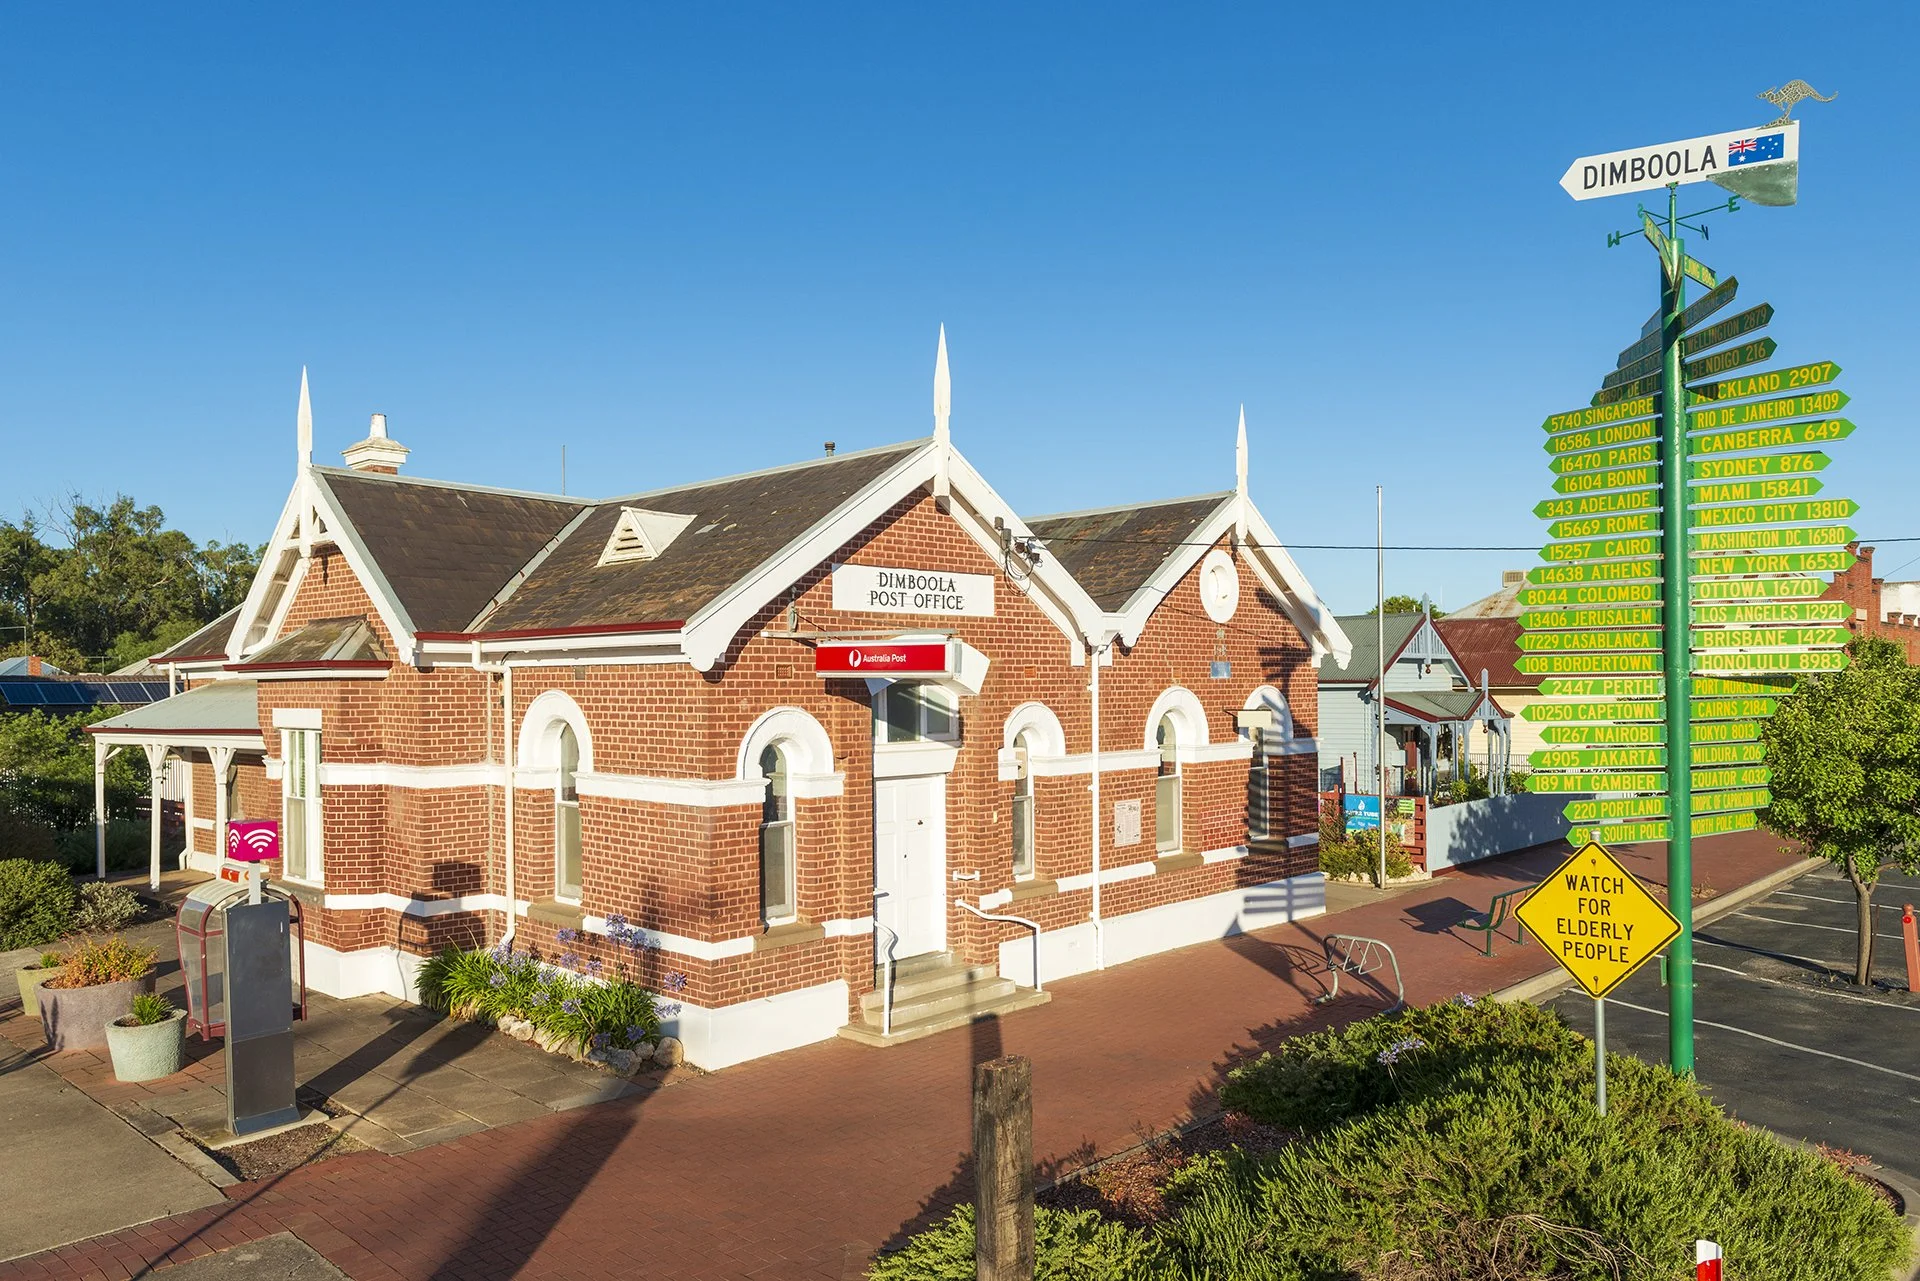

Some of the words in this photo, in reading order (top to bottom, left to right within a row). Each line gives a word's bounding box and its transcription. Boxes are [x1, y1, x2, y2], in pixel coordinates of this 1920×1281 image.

[1584, 145, 1717, 189] DIMBOOLA
[1687, 318, 1739, 351] WELLINGTON
[1743, 306, 1767, 329] 2879
[1691, 349, 1740, 379] BENDIGO
[1745, 342, 1766, 363] 216
[1627, 375, 1657, 399] DELHI
[1696, 373, 1780, 404] AUCKLAND
[1789, 363, 1832, 387] 2907
[1551, 412, 1581, 432] 5740
[1585, 397, 1654, 425] SINGAPORE
[1697, 411, 1716, 428] RIO
[1721, 408, 1736, 425] DE
[1742, 399, 1795, 422] JANEIRO
[1800, 392, 1839, 414] 13409
[1555, 432, 1591, 452] 16586
[1597, 421, 1651, 445] LONDON
[1701, 427, 1794, 453] CANBERRA
[1804, 421, 1841, 441] 649
[1560, 453, 1601, 472] 16470
[1608, 445, 1651, 466] PARIS
[1701, 457, 1771, 478] SYDNEY
[1780, 454, 1814, 472] 876
[1564, 474, 1602, 492] 16104
[1607, 468, 1647, 487] BONN
[1700, 483, 1750, 503] MIAMI
[1761, 479, 1809, 498] 15841
[1546, 500, 1573, 517] 343
[1579, 491, 1650, 514] ADELAIDE
[1700, 506, 1757, 526] MEXICO
[1763, 504, 1799, 521] CITY
[1806, 500, 1849, 519] 13810
[1558, 519, 1600, 537] 15669
[1606, 514, 1649, 533] ROME
[1549, 543, 1592, 560] 15257
[1605, 538, 1651, 556] CAIRO
[1700, 530, 1779, 550] WASHINGTON
[1785, 529, 1801, 546] DC
[1808, 527, 1845, 545] 16580
[1540, 566, 1584, 584] 14638
[1591, 561, 1651, 580] ATHENS
[1700, 557, 1735, 575] NEW
[1744, 555, 1790, 573] YORK
[1799, 552, 1846, 570] 16531
[878, 571, 956, 593] DIMBOOLA
[1700, 580, 1767, 598] OTTOWA
[1773, 579, 1818, 596] 16701
[870, 590, 907, 607] POST
[914, 593, 964, 611] OFFICE
[1528, 588, 1568, 605] 8044
[1577, 585, 1651, 603] COLOMBO
[1529, 612, 1567, 627] 13406
[1572, 608, 1651, 626] JERUSALEM
[1701, 606, 1727, 622] LOS
[1735, 605, 1798, 621] ANGELES
[1805, 603, 1843, 620] 12921
[1524, 634, 1560, 650] 17229
[1563, 632, 1650, 649] CASABLANCA
[1703, 630, 1788, 647] BRISBANE
[1796, 628, 1837, 645] 1422
[863, 653, 891, 663] Australia
[892, 653, 907, 663] Post
[1525, 657, 1549, 672] 108
[1553, 655, 1652, 672] BORDERTOWN
[1702, 653, 1790, 670] HONOLULU
[1799, 653, 1842, 670] 8983
[1552, 680, 1594, 696] 2447
[1603, 679, 1654, 695] PERTH
[1695, 679, 1719, 695] PORT
[1723, 677, 1765, 694] MORESBY
[1769, 677, 1793, 694] 3038
[1531, 704, 1573, 721] 10250
[1577, 703, 1655, 720] CAPETOWN
[1698, 701, 1738, 718] CAIRNS
[1742, 700, 1768, 716] 2184
[1551, 727, 1589, 743] 11267
[1594, 726, 1654, 743] NAIROBI
[1694, 725, 1727, 741] TOKYO
[1731, 723, 1755, 739] 8013
[1541, 751, 1580, 767] 4905
[1590, 749, 1657, 766] JAKARTA
[1693, 746, 1738, 763] MILDURA
[1742, 745, 1761, 761] 206
[1535, 775, 1559, 791] 189
[1563, 775, 1584, 791] MT
[1591, 774, 1656, 791] GAMBIER
[1692, 770, 1737, 788] EQUATOR
[1741, 768, 1767, 784] 4032
[1574, 802, 1597, 820] 220
[1600, 799, 1662, 818] PORTLAND
[1692, 795, 1712, 811] TROPIC
[1713, 794, 1721, 810] OF
[1722, 791, 1754, 809] CAPRICORN
[1576, 827, 1601, 845] 59
[1603, 824, 1636, 843] SOUTH
[1639, 822, 1665, 840] POLE
[1692, 818, 1713, 836] NORTH
[1716, 815, 1733, 832] POLE
[1565, 874, 1624, 895] WATCH
[1578, 898, 1611, 916] FOR
[1557, 918, 1634, 941] ELDERLY
[1563, 941, 1629, 963] PEOPLE
